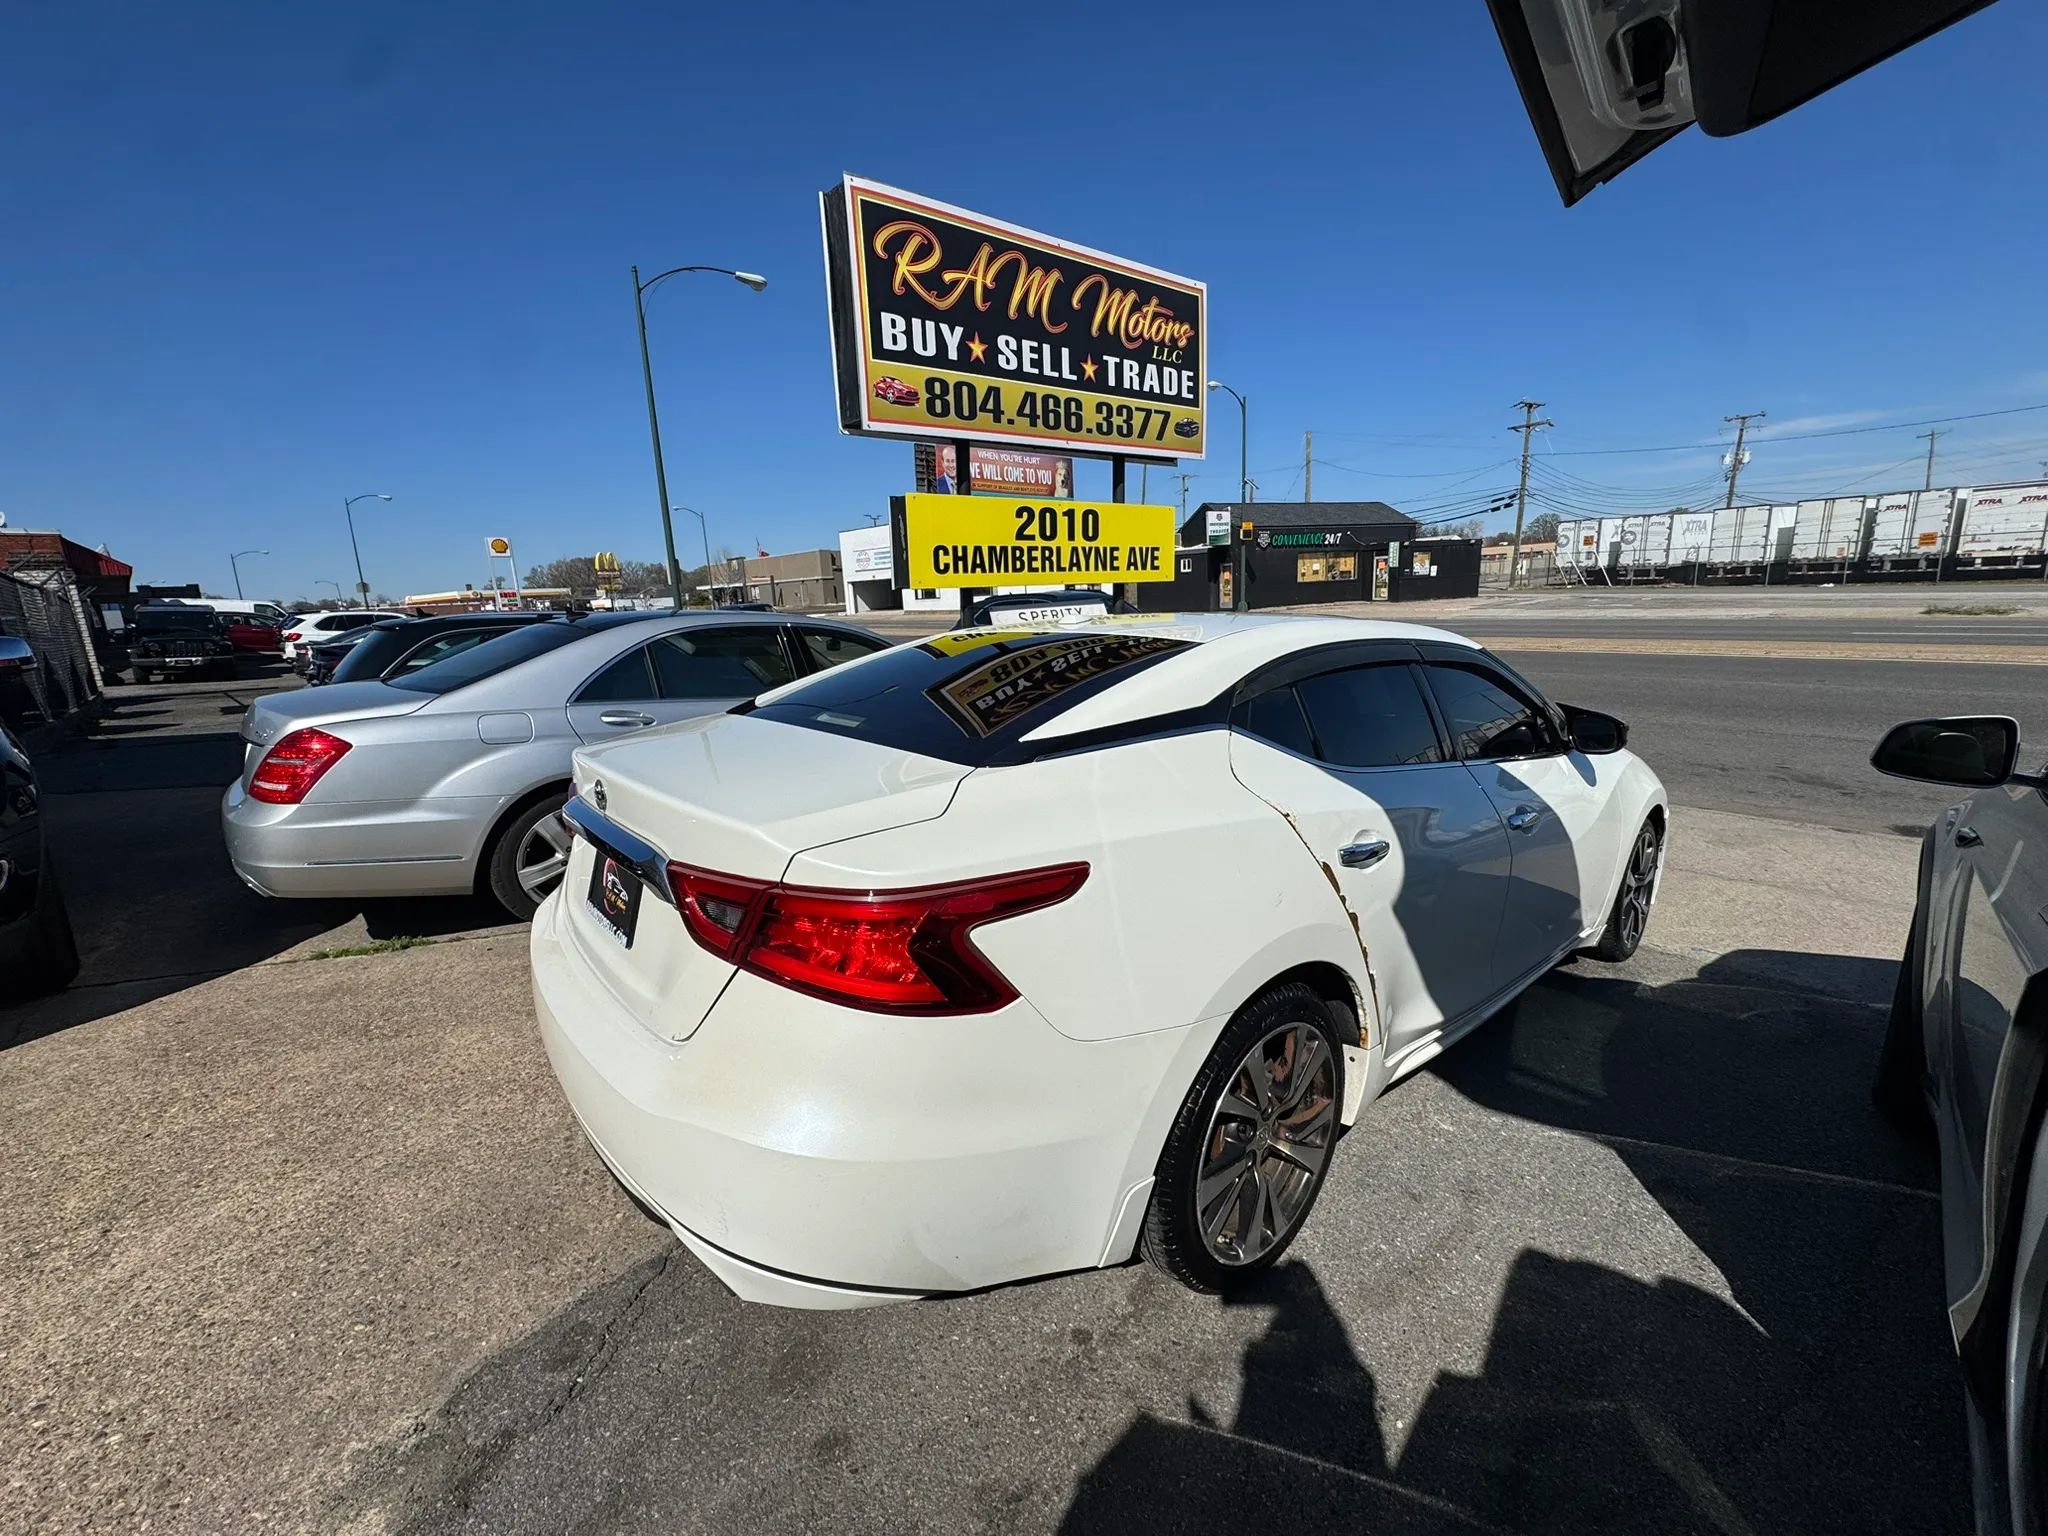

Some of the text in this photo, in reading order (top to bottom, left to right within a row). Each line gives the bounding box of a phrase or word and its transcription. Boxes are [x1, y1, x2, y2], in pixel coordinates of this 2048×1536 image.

[873, 221, 1194, 349] RAM Motors
[880, 312, 1194, 399] BUY SELL TRADE
[1152, 345, 1183, 363] LLC
[924, 377, 1171, 441] 804.466.3377
[977, 449, 1041, 465] WHEN YOU'RE HURT
[982, 463, 1002, 481] WILL
[1004, 465, 1025, 482] COME
[1025, 468, 1035, 484] TO
[1036, 469, 1052, 485] YOU
[1883, 504, 1907, 512] XTRA
[1975, 498, 2003, 507] XTRA
[2018, 495, 2048, 504] XTRA
[1015, 506, 1100, 542] 2010
[1682, 519, 1708, 535] XTRA
[1272, 532, 1342, 546] CONVENIENCE 24/7
[933, 545, 1160, 574] CHAMBERLAYNE AVE
